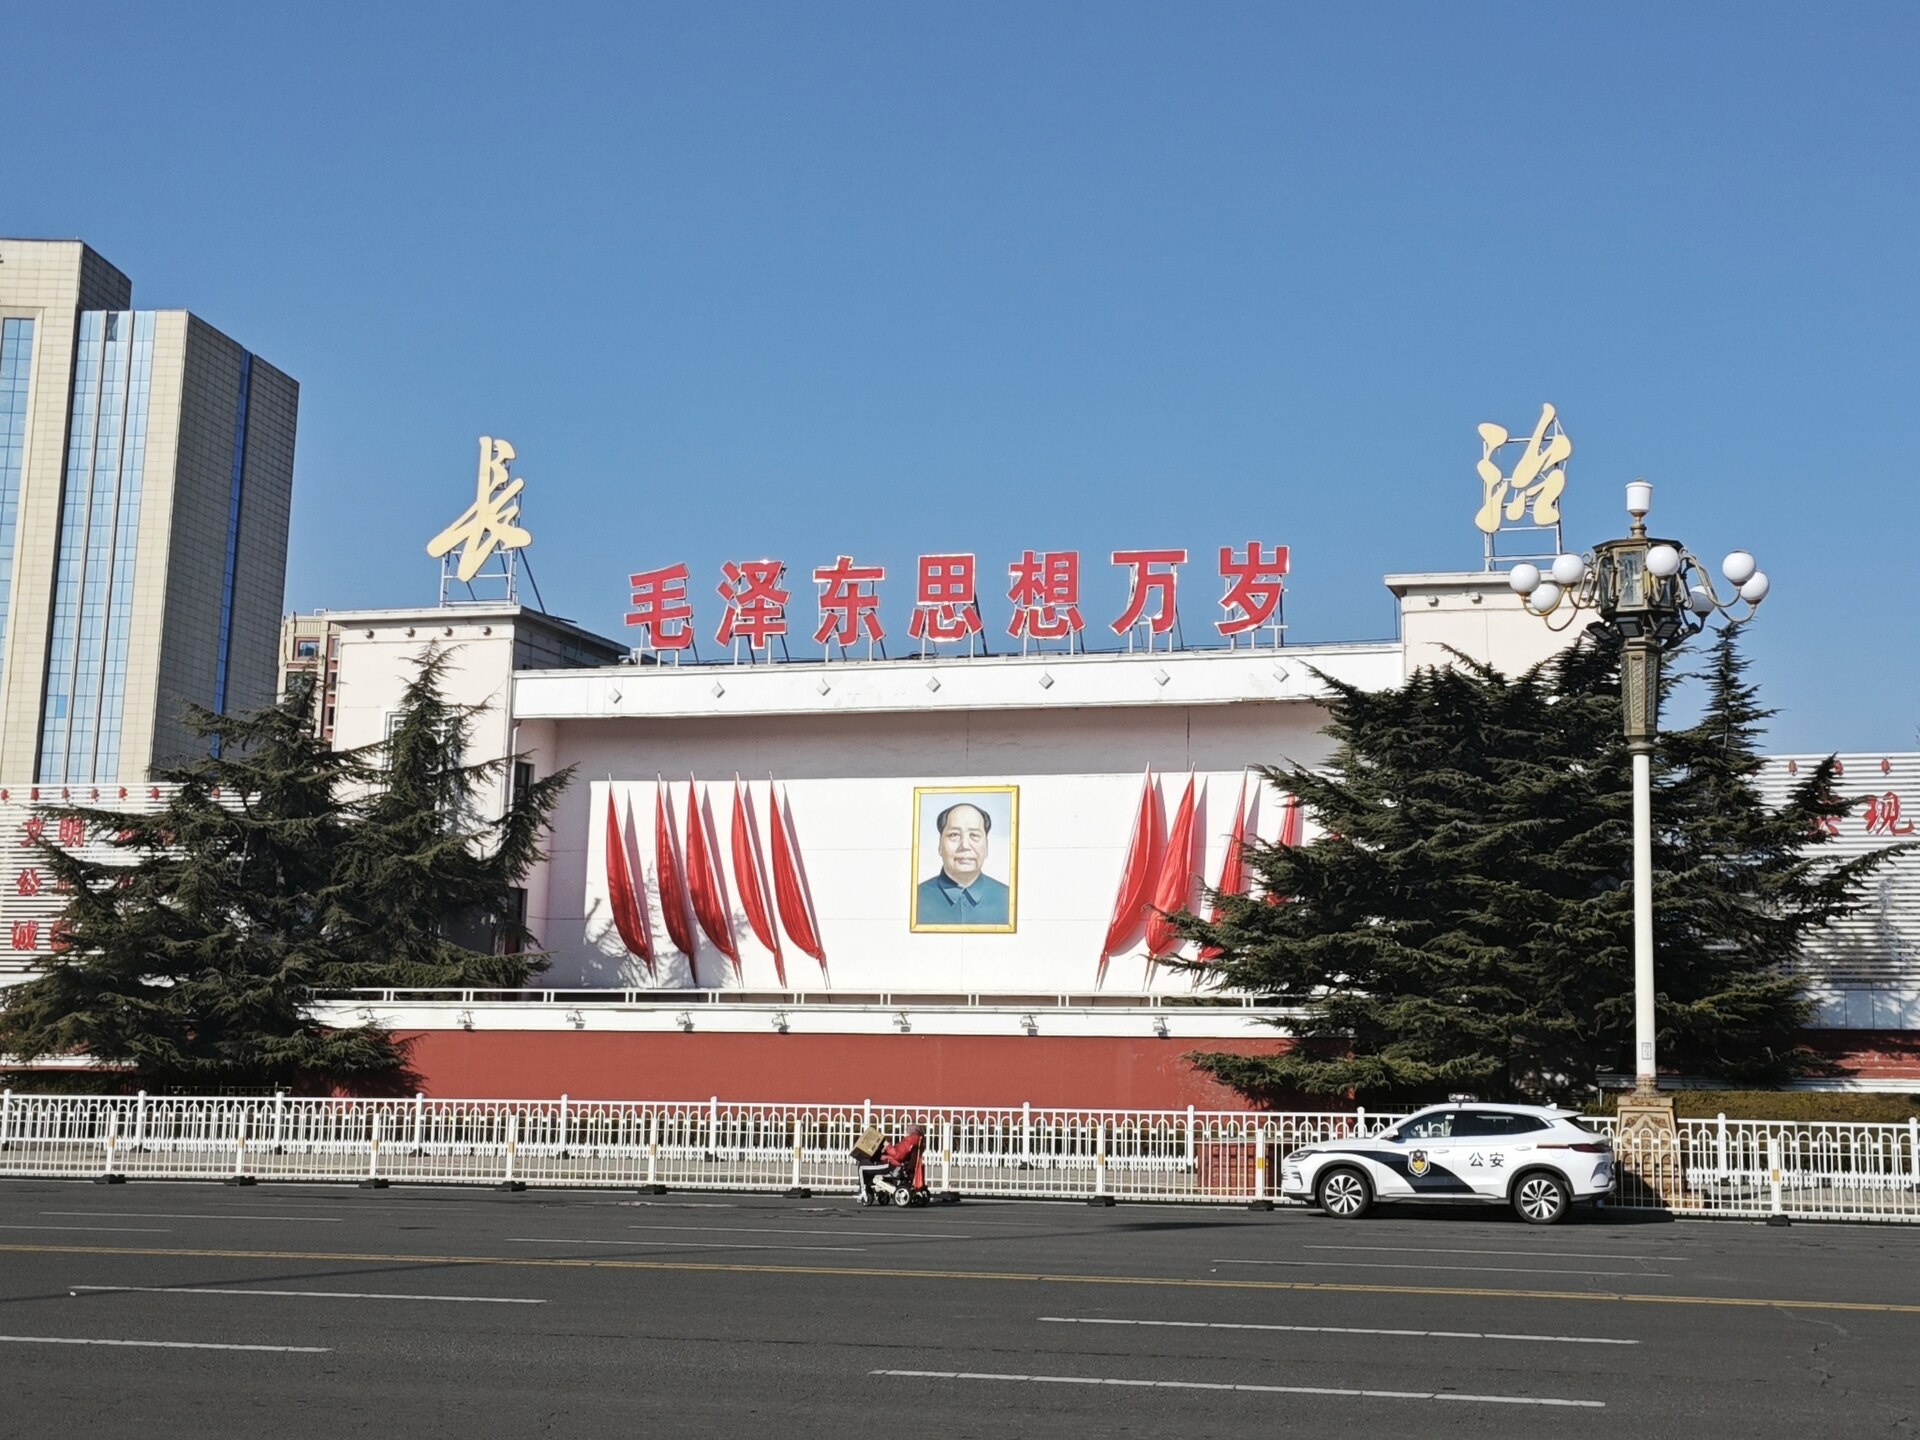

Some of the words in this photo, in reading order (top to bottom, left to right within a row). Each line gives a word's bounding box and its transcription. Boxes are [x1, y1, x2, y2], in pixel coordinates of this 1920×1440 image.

[625, 541, 1290, 650] 毛泽东思想万岁
[1469, 1152, 1505, 1168] 公安
